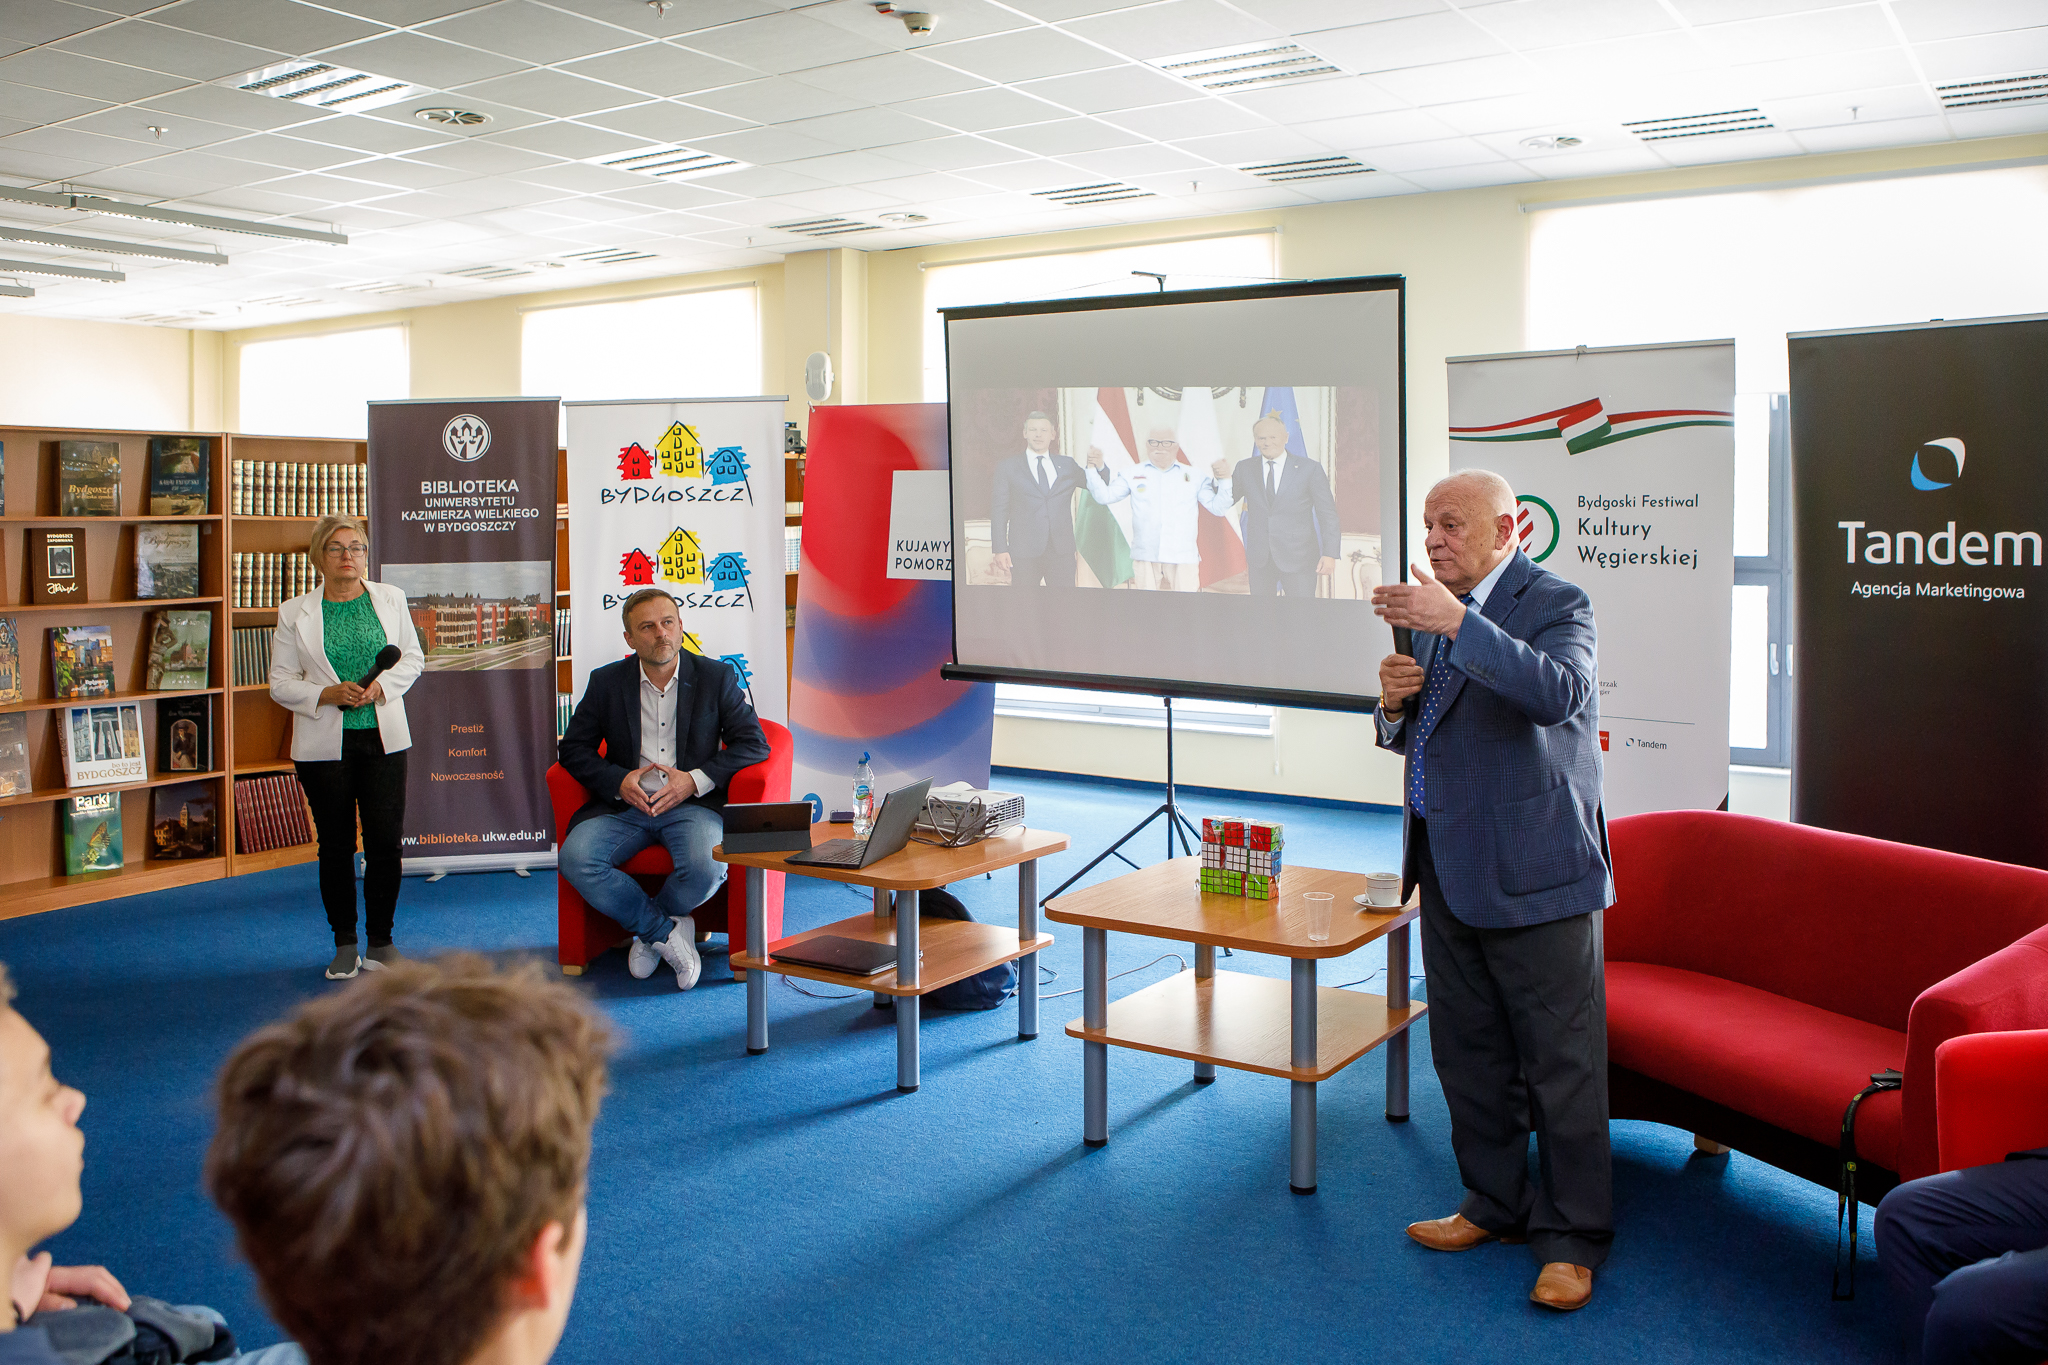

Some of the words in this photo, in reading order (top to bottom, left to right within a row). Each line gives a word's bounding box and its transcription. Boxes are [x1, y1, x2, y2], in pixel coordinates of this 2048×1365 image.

[421, 479, 519, 494] BIBLIOTEKA
[425, 496, 515, 508] UNIWERSYTETU
[601, 486, 744, 504] BYDGOSZCZ
[1578, 494, 1636, 511] Bydgoski
[1641, 493, 1699, 508] Festiwal
[401, 510, 471, 521] KAZIMIERZA
[474, 508, 539, 519] WIELKIEGO
[423, 523, 435, 533] W
[438, 521, 516, 532] BYDGOSZCZY
[1578, 516, 1652, 541] Kultury
[896, 540, 951, 552] KUJAWY
[1837, 521, 2043, 566] Tandem
[895, 557, 952, 571] POMORZ
[1577, 545, 1698, 570] Węgierskiej
[1851, 581, 1911, 599] Agencja
[1915, 582, 2025, 602] Marketingowa
[450, 724, 485, 734] Prestiż
[1637, 739, 1668, 750] Tandem
[448, 748, 487, 758] Komfort
[76, 766, 143, 781] BYDGOSZCZ
[430, 770, 505, 782] Nowoczesność
[75, 792, 110, 811] Parki
